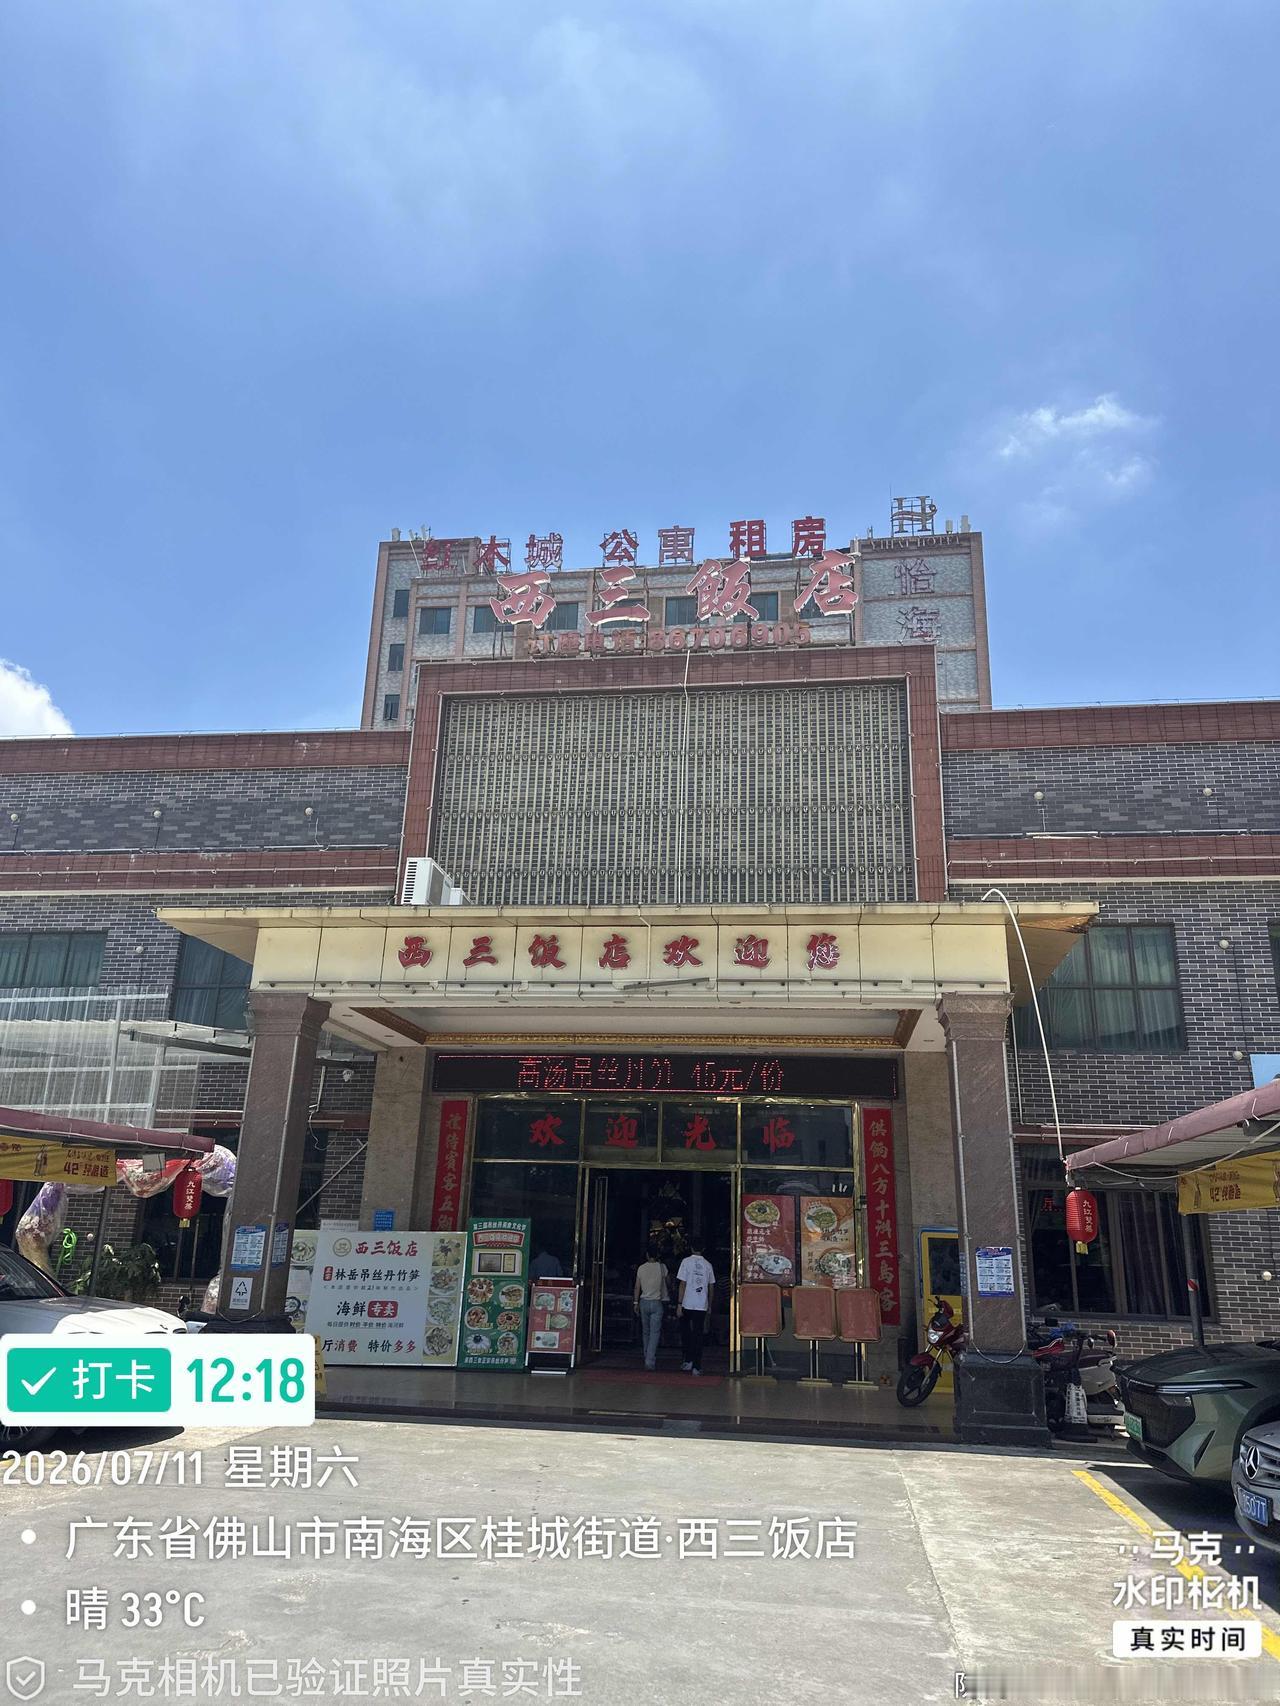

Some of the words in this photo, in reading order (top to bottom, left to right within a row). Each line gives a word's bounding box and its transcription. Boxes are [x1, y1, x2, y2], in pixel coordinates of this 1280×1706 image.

[599, 524, 696, 564] 公寓
[729, 515, 826, 559] 租房
[398, 932, 841, 970] 西三饭店欢迎您
[529, 1113, 797, 1152] 欢迎光临
[355, 1239, 418, 1257] 西三饭店
[334, 1267, 420, 1282] 林岳吊丝丹竹笋
[336, 1300, 366, 1317] 海鲜
[371, 1302, 395, 1316] 专卖
[367, 1339, 417, 1353] 特价多多
